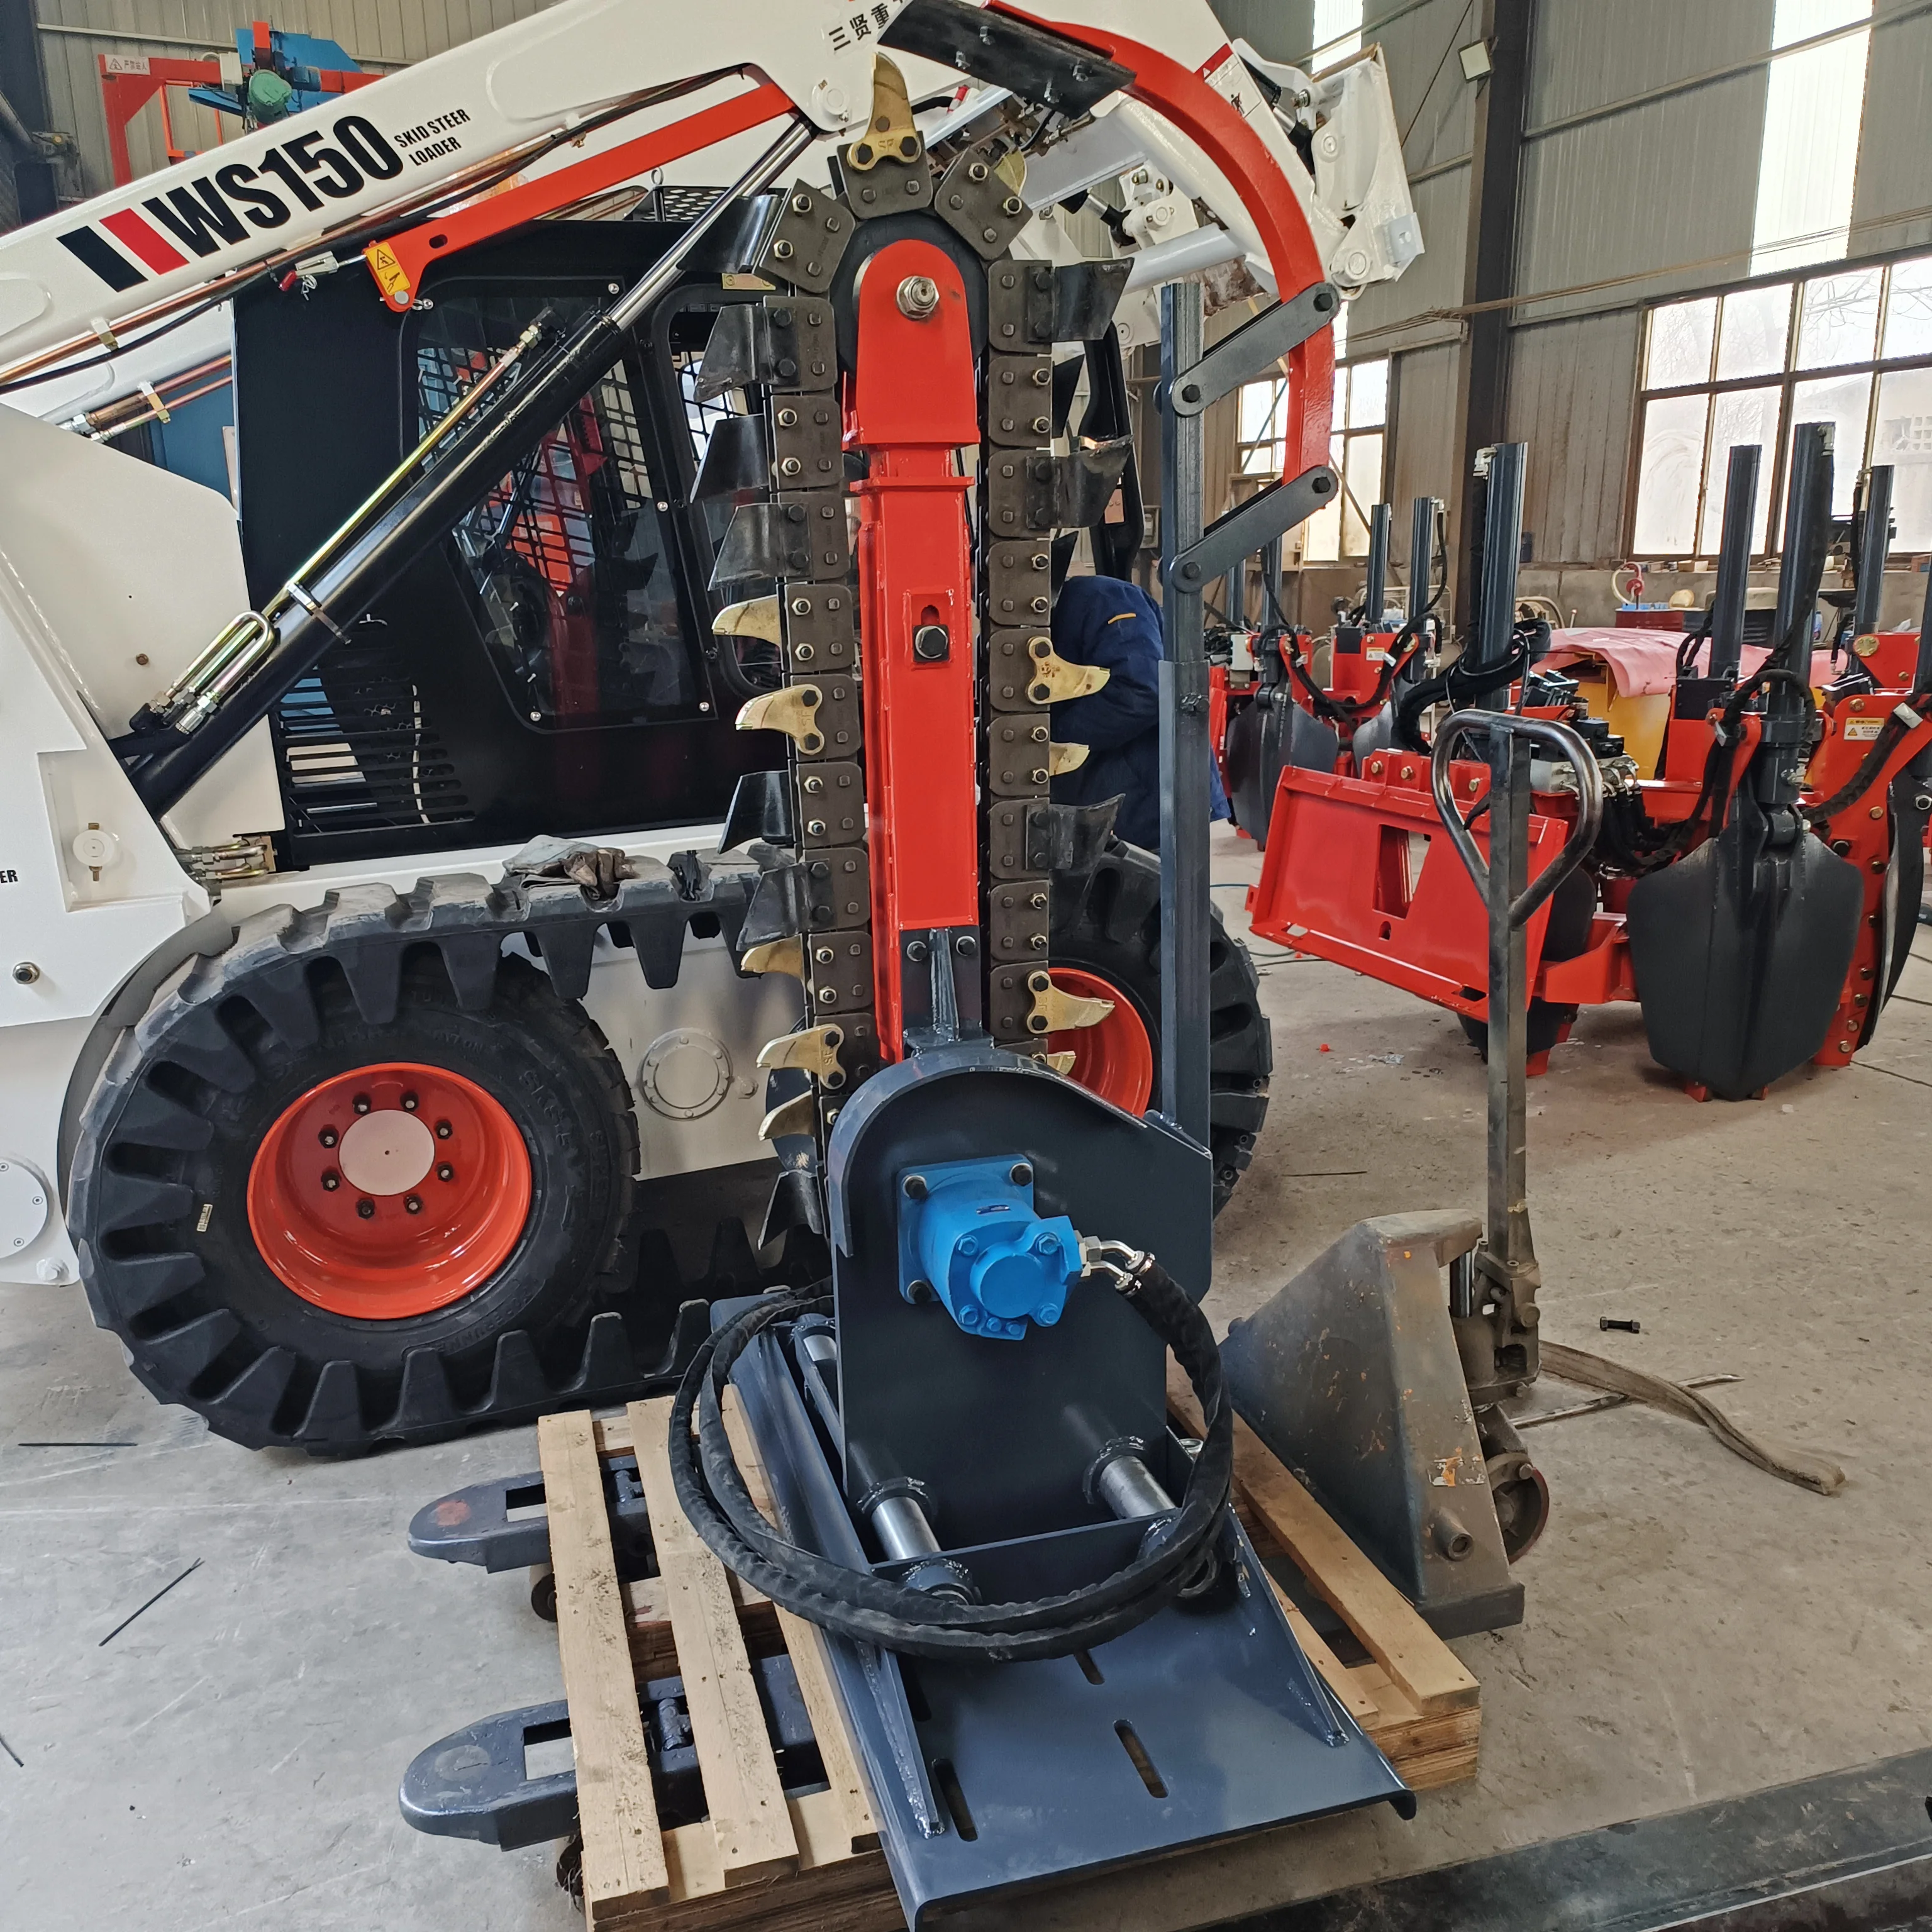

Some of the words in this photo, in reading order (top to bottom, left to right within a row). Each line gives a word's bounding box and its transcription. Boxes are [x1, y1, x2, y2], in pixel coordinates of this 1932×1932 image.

[828, 0, 903, 51] 三贤重
[394, 125, 430, 148] SKID
[426, 109, 471, 135] STEER
[408, 136, 462, 166] LOADER
[140, 115, 404, 258] WS150
